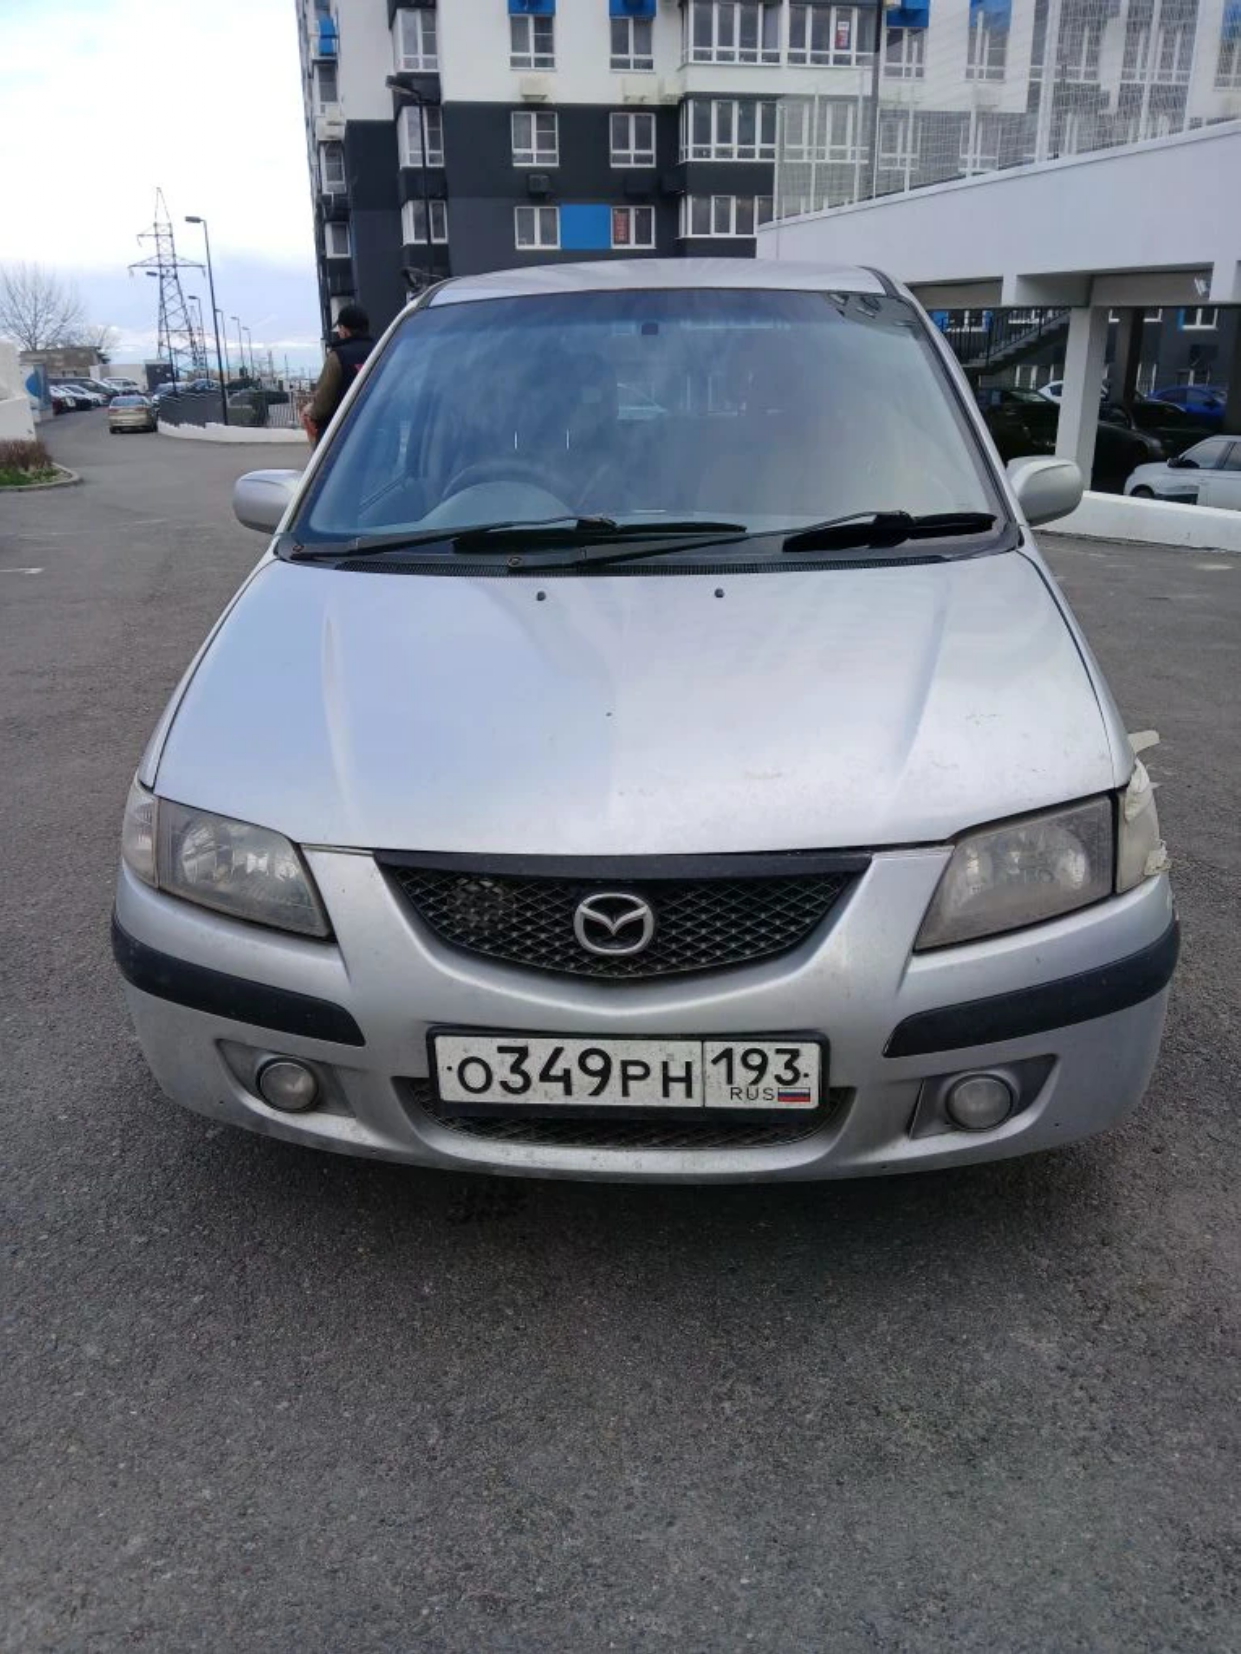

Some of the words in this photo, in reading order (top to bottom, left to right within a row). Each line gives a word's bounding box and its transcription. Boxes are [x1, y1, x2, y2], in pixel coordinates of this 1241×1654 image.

[457, 1046, 693, 1098] О349РН
[711, 1047, 801, 1086] 193
[730, 1087, 775, 1101] RUS
